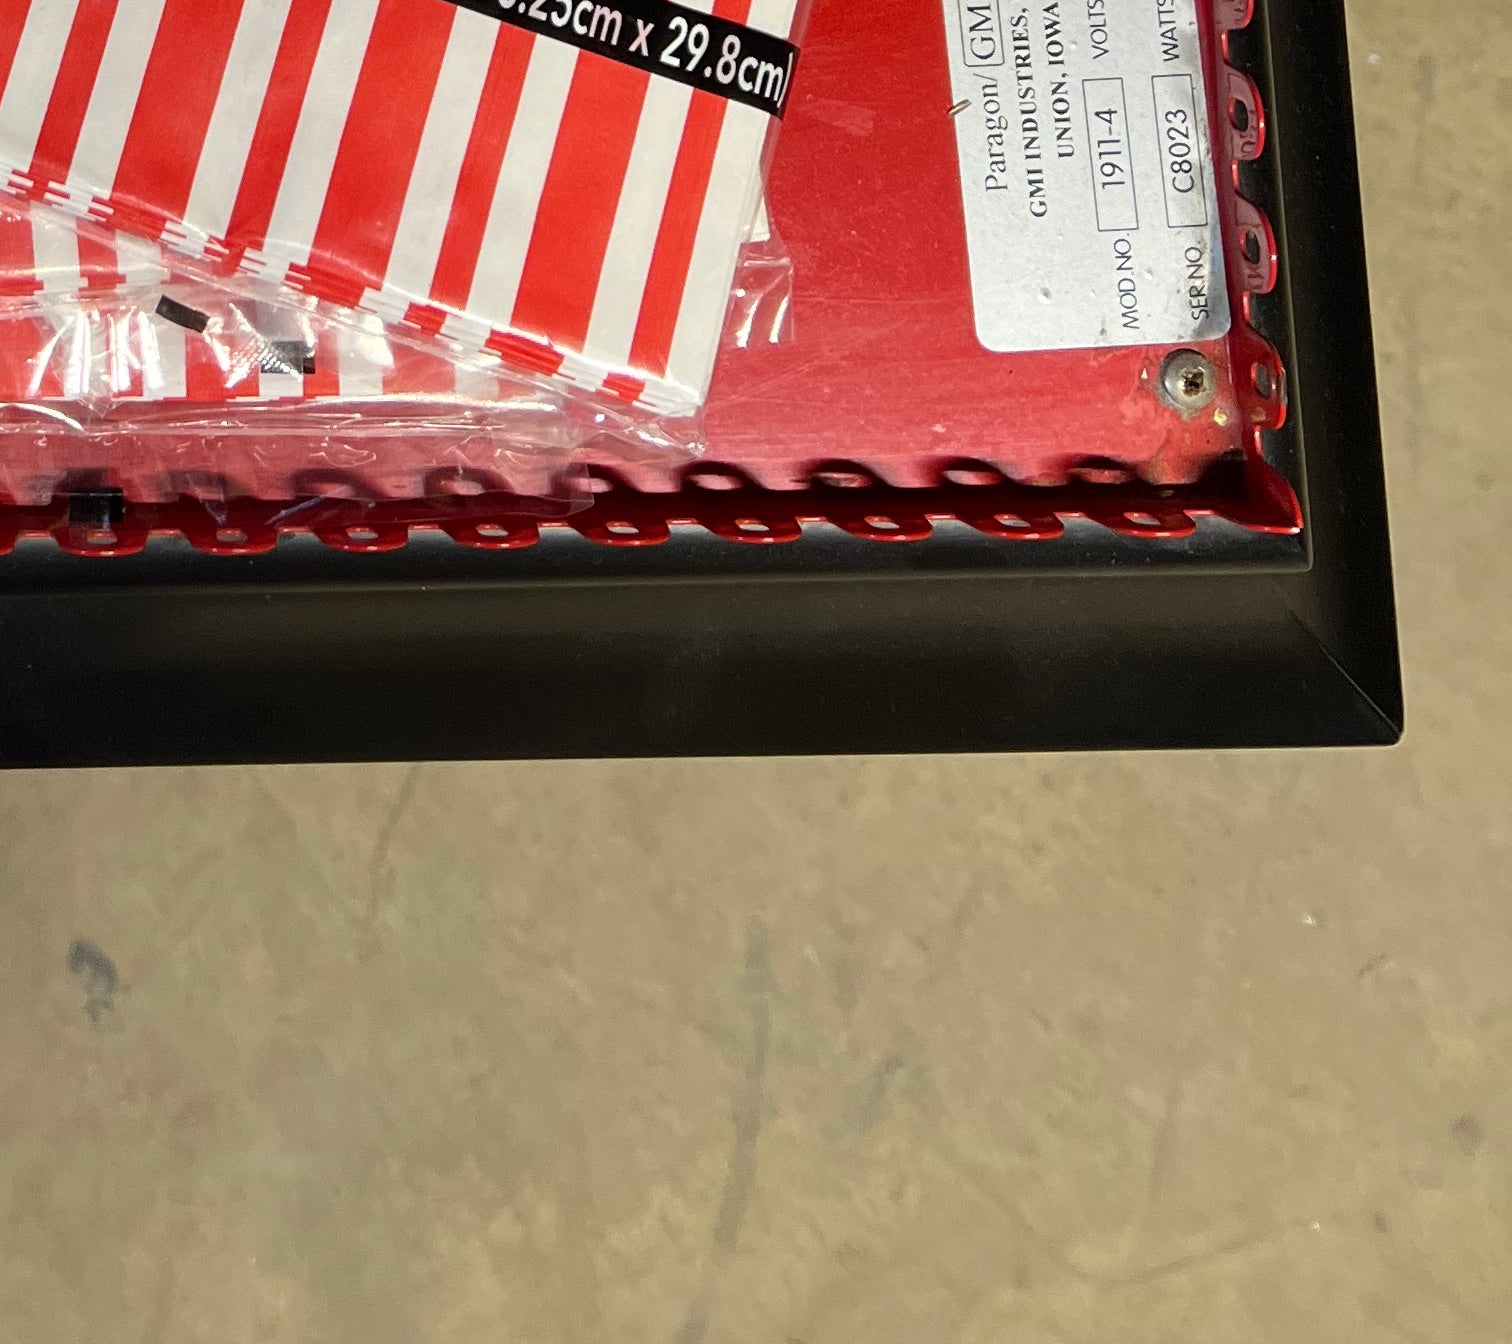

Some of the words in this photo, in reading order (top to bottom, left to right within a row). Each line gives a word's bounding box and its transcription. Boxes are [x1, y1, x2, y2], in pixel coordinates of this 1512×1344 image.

[629, 17, 655, 57] x
[659, 16, 794, 110] 29.8cm)
[1042, 2, 1067, 69] IOWA
[1011, 9, 1045, 165] INDUSTRIES,
[1047, 74, 1076, 160] UNION,
[1094, 107, 1126, 190] 1911-4
[1165, 107, 1195, 194] C8023
[1027, 169, 1048, 218] GMI
